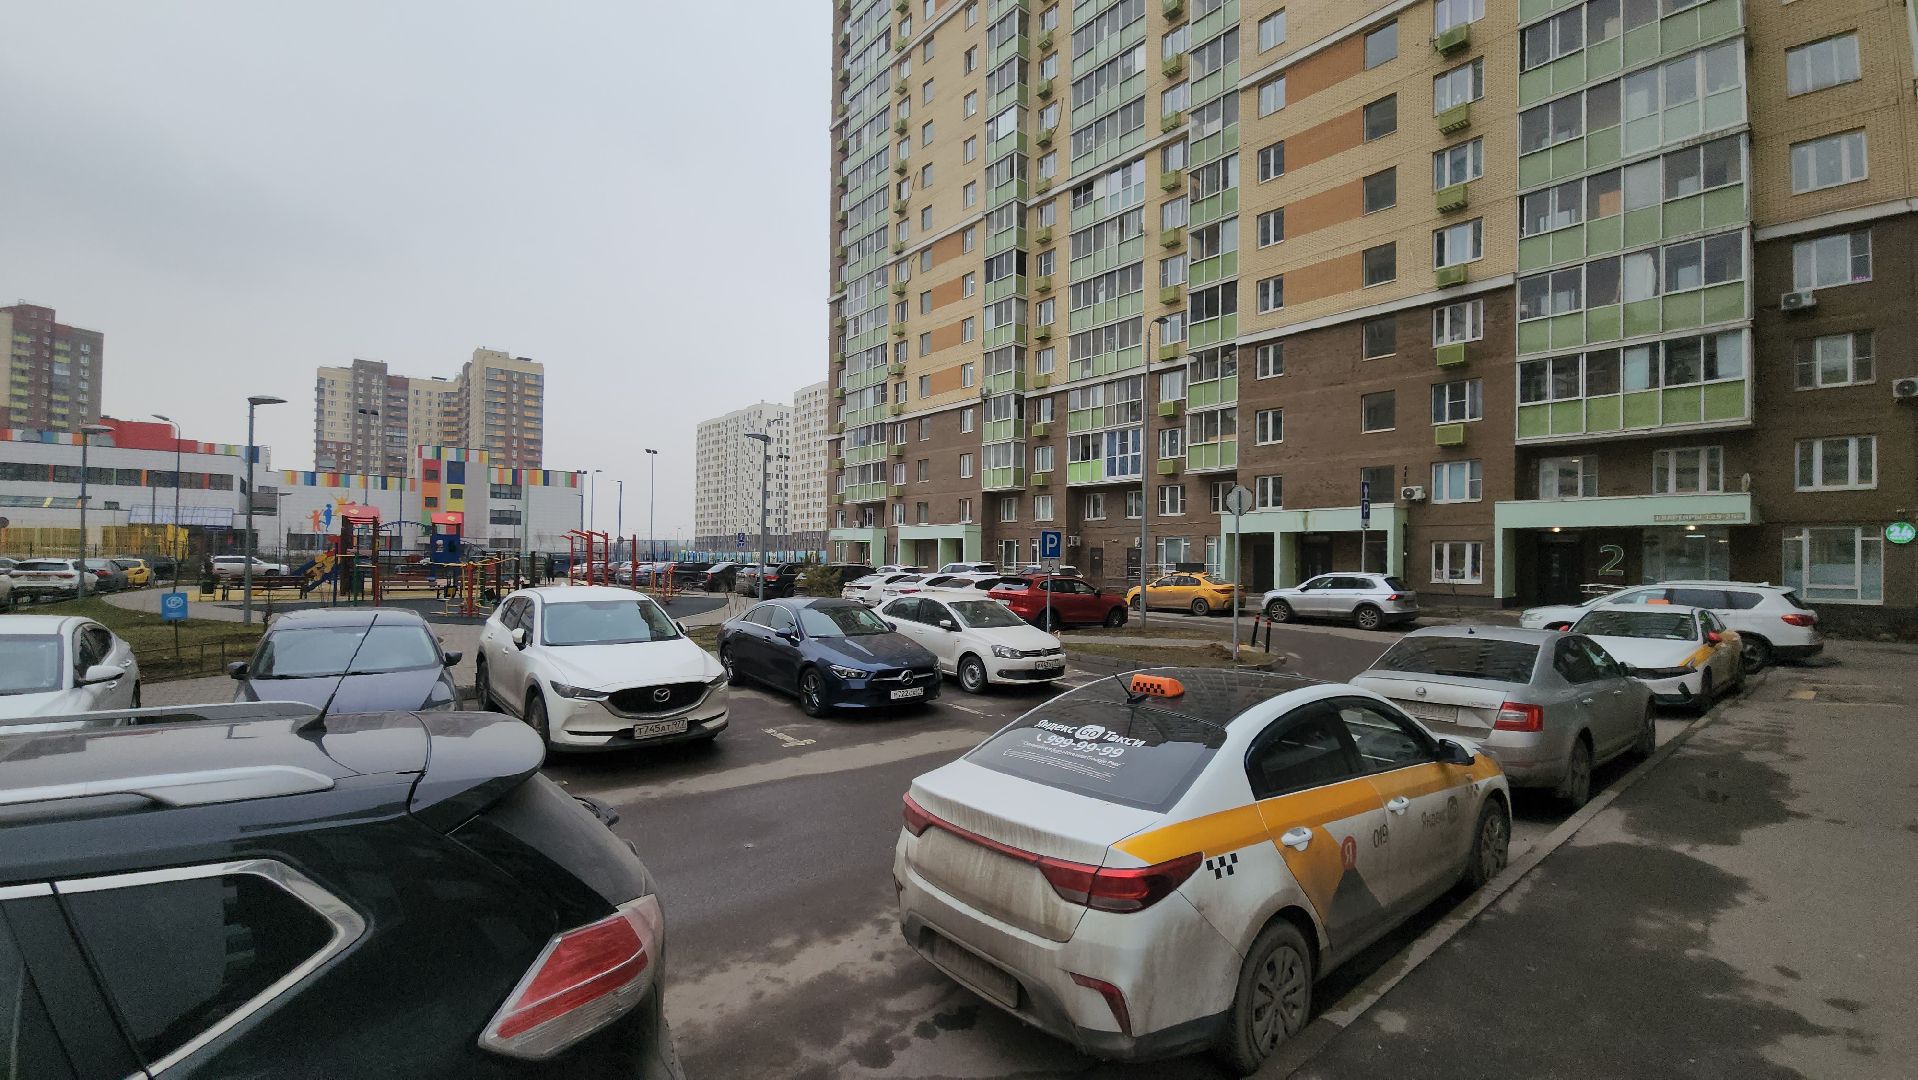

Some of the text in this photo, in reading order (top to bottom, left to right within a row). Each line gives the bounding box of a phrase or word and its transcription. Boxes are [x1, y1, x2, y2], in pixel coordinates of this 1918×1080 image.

[1046, 533, 1058, 555] P
[1599, 544, 1624, 576] 2
[1033, 719, 1078, 734] Яндекс
[1102, 730, 1147, 747] Такси
[1043, 733, 1125, 758] 999-99-99
[1373, 824, 1389, 848] 019
